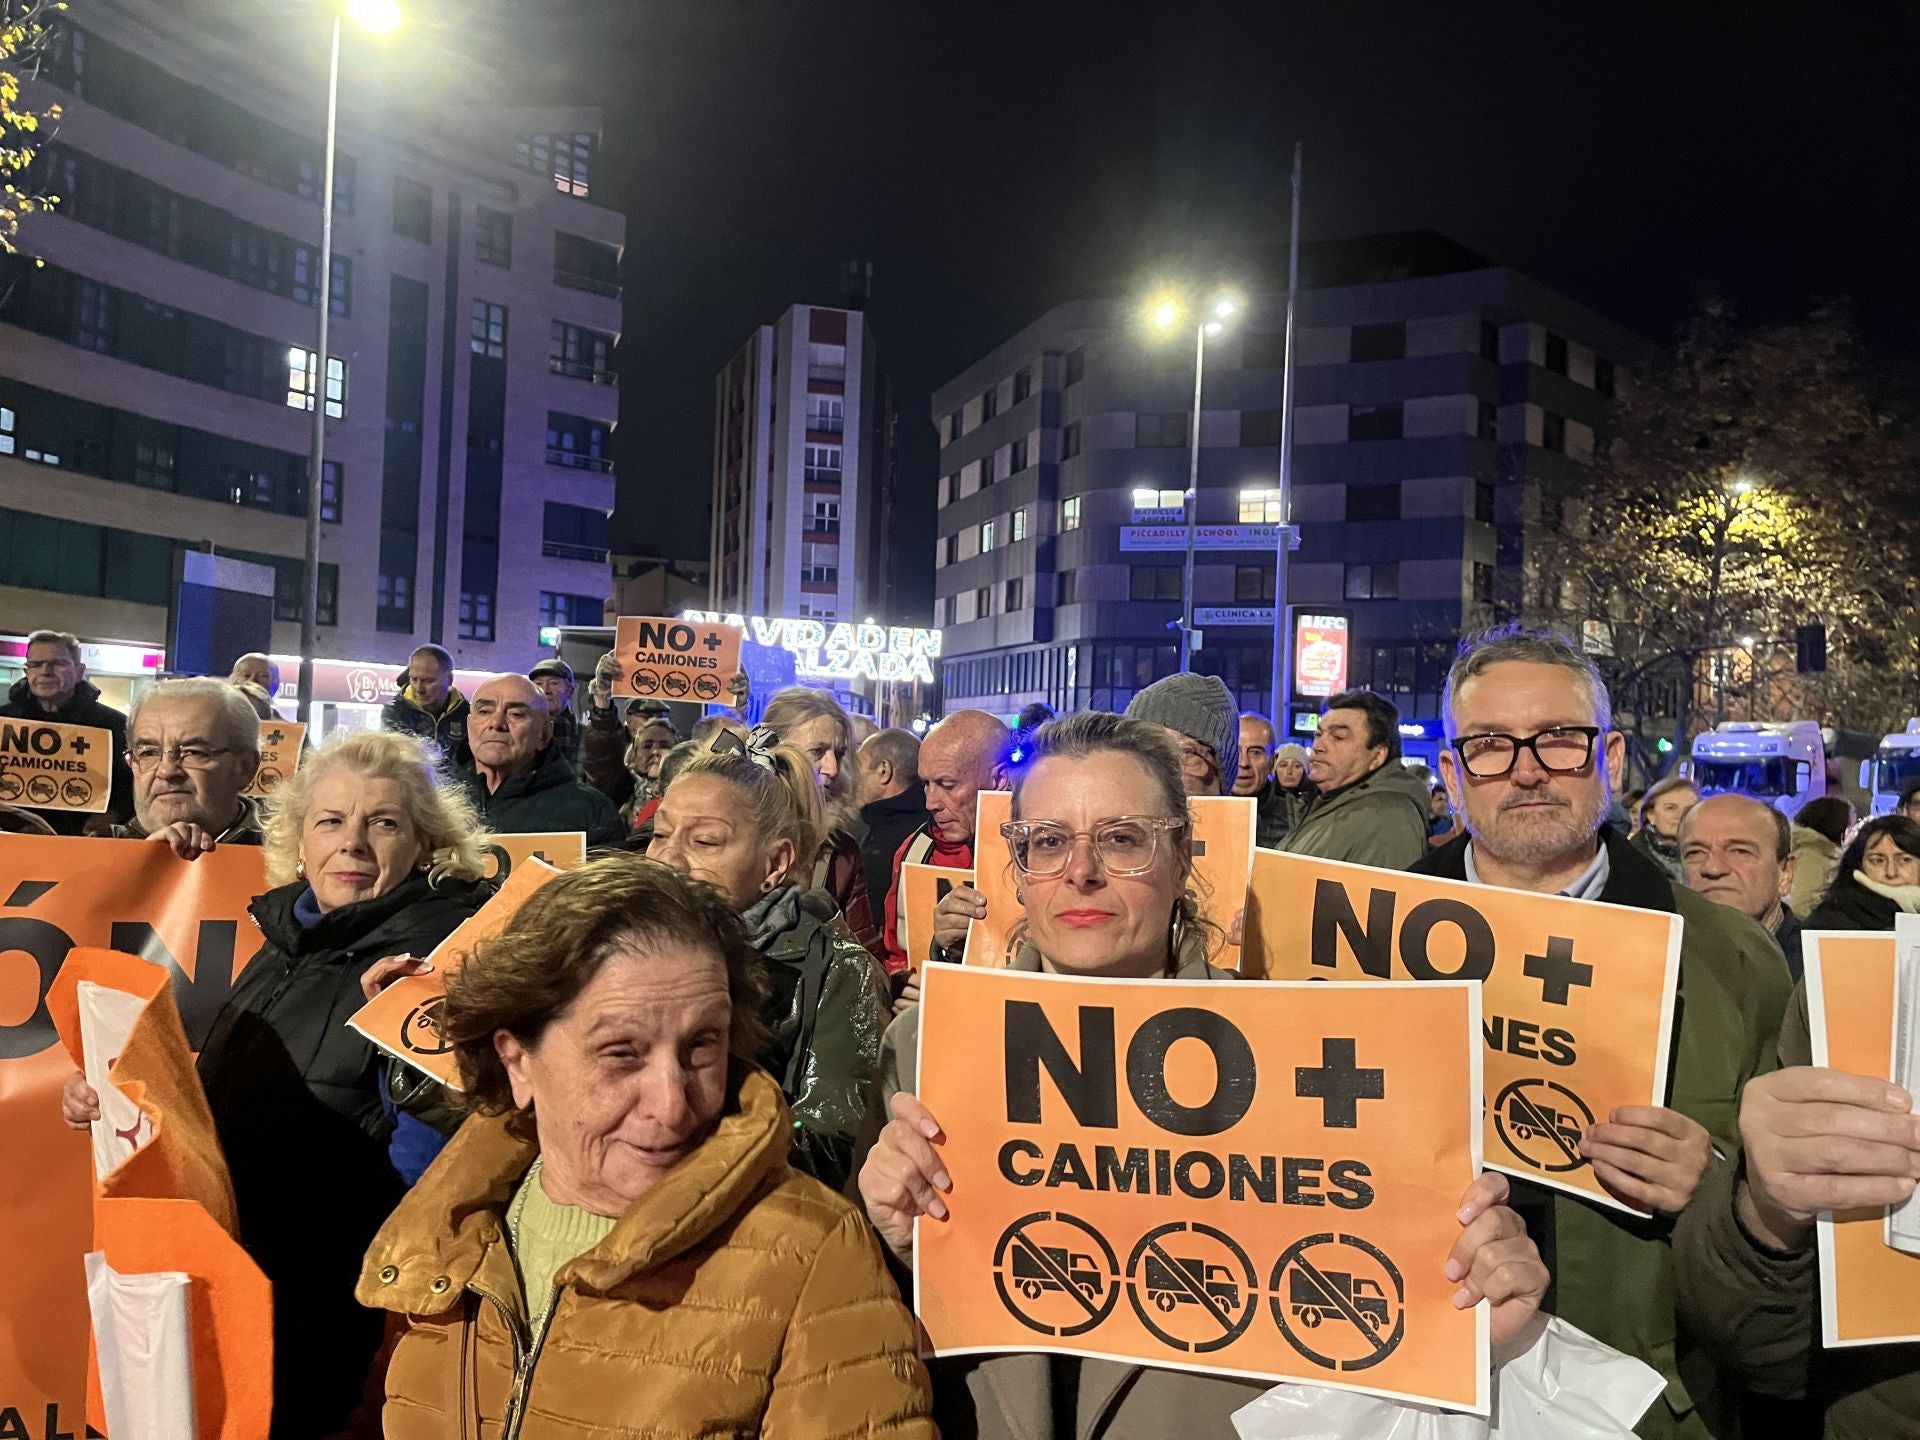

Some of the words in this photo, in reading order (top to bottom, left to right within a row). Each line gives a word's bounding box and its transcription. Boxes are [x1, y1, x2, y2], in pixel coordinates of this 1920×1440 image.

[1196, 529, 1239, 537] SCHOOL
[1248, 528, 1277, 536] INGL
[638, 622, 696, 652] NO
[703, 632, 722, 651] +
[1312, 616, 1345, 629] KFC
[635, 651, 718, 669] CAMIONES
[1, 724, 62, 755] NO
[70, 736, 91, 755] +
[0, 755, 87, 773] CAMIONES
[1311, 878, 1496, 984] NO
[1522, 935, 1594, 1006] +
[1005, 999, 1256, 1136] NO
[1295, 1037, 1384, 1129] +
[997, 1139, 1375, 1210] CAMIONES
